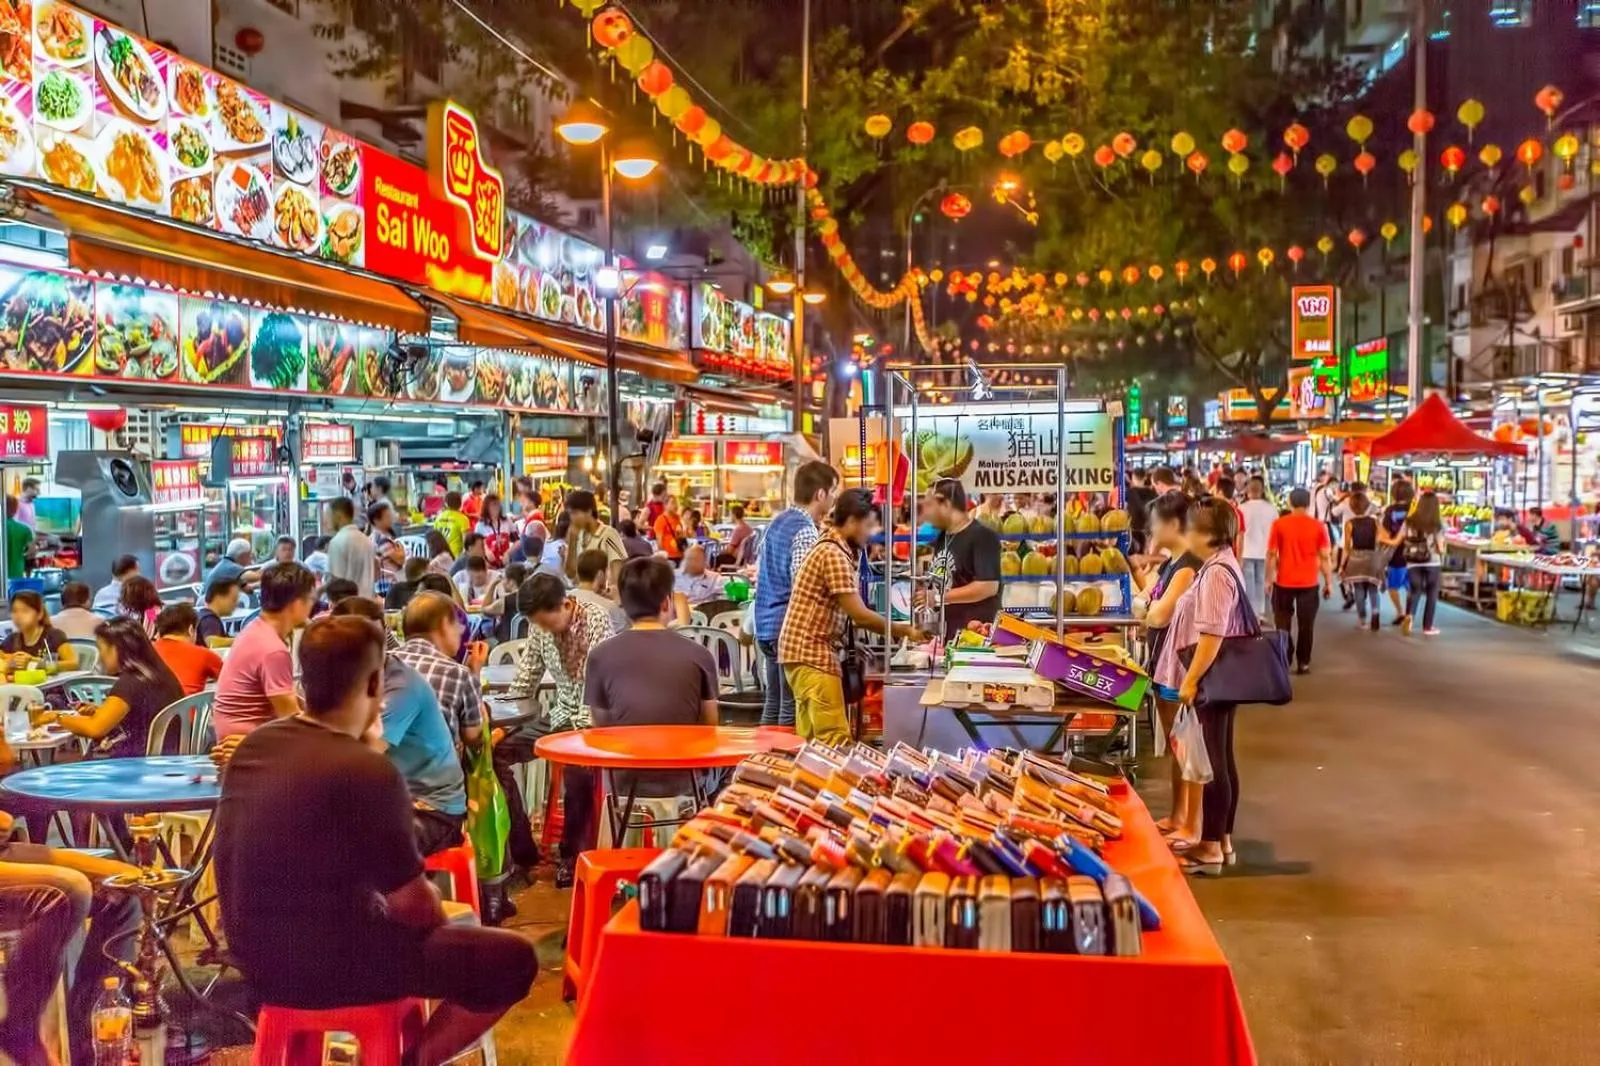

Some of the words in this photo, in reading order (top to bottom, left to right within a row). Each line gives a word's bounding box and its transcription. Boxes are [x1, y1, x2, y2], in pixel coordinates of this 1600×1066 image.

[375, 176, 418, 209] Restaurant
[377, 202, 408, 250] Sai
[413, 213, 450, 262] Woo
[6, 439, 26, 453] MEE
[978, 459, 1017, 468] Malaysia
[1019, 459, 1040, 467] Local
[1042, 458, 1059, 467] Frui
[975, 469, 1058, 488] MUSANG
[1065, 467, 1113, 486] KING
